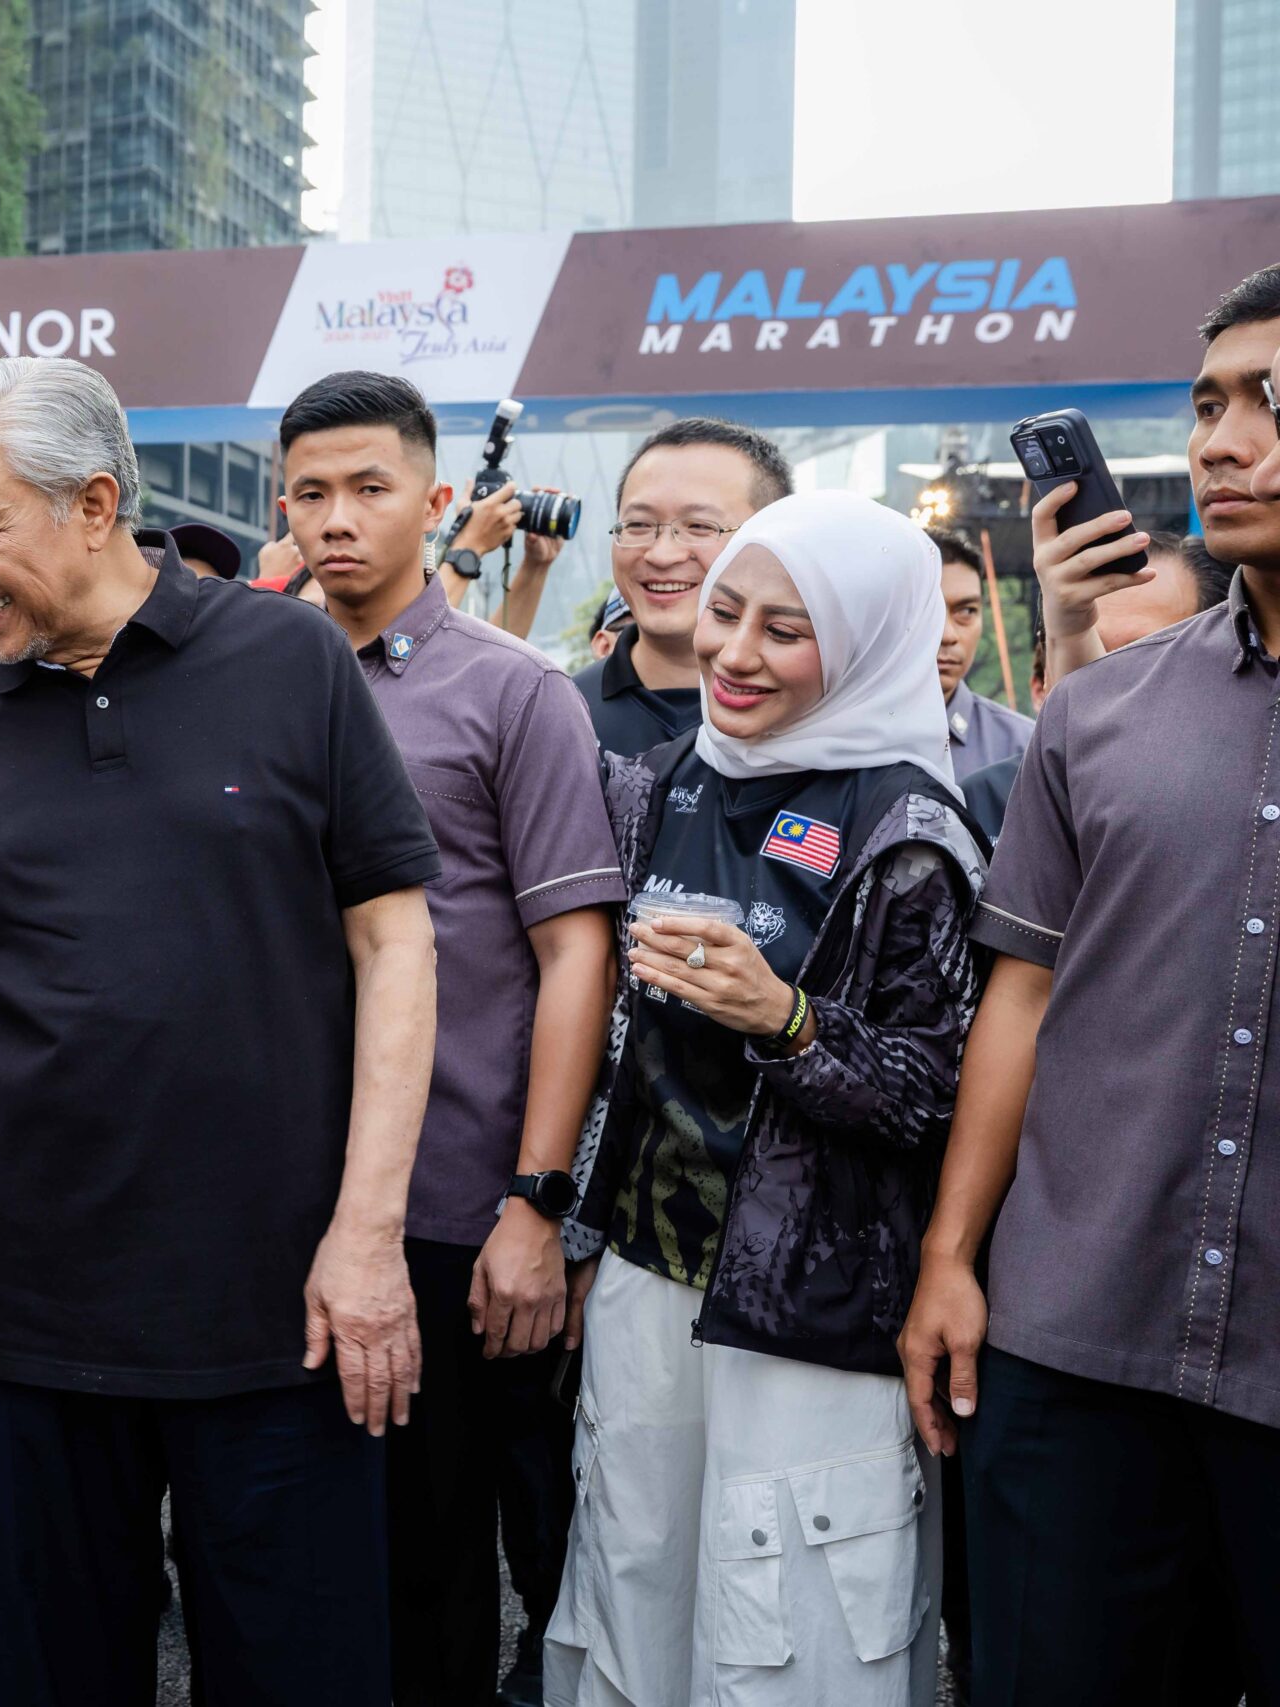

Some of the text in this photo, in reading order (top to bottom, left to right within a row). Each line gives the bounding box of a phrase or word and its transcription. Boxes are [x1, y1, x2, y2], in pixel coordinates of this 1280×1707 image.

[316, 291, 469, 333] Malaysia
[646, 257, 1077, 324] MALAYSIA
[639, 310, 1076, 354] MARATHON
